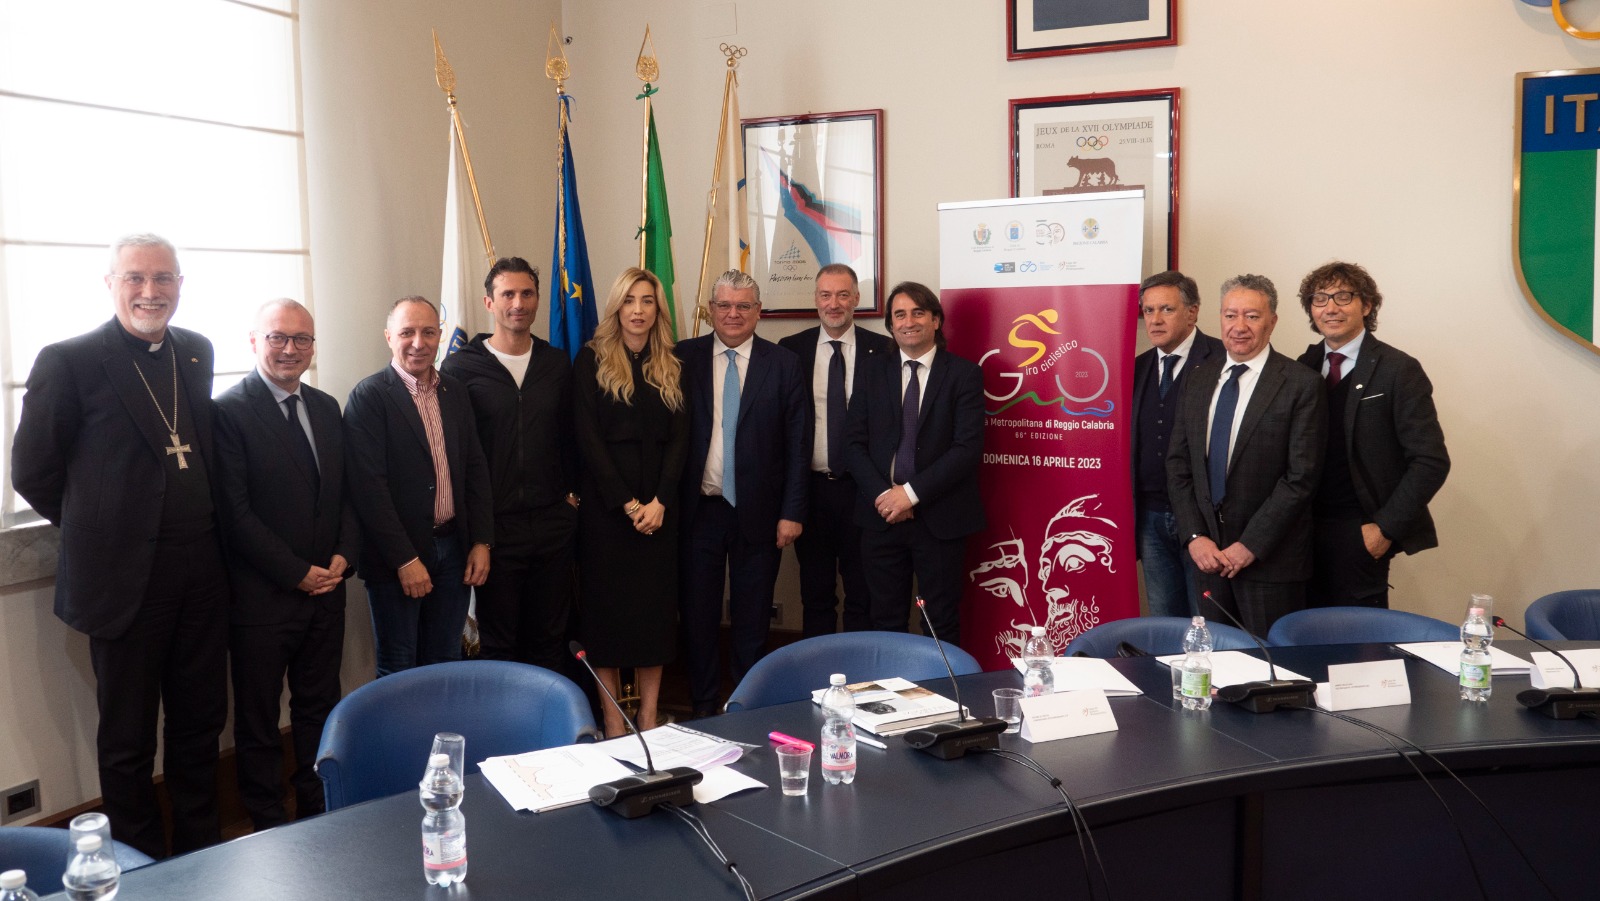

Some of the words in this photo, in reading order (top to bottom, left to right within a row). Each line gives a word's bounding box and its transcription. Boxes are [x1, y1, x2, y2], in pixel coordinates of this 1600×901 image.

[1036, 126, 1058, 137] JEUX
[1082, 124, 1100, 133] XVII
[1102, 121, 1153, 131] OLYMPIADE
[1040, 340, 1078, 372] ciclistico
[990, 418, 1043, 428] Metropolitana
[1045, 420, 1052, 428] di
[1053, 420, 1080, 431] Reggio
[1081, 420, 1115, 430] Calabria
[1030, 432, 1063, 440] EDIZIONE
[983, 453, 1030, 466] DOMENICA
[1031, 455, 1041, 466] 16
[1043, 456, 1076, 469] APRILE
[1077, 458, 1101, 469] 2023
[830, 752, 853, 760] VALMORA
